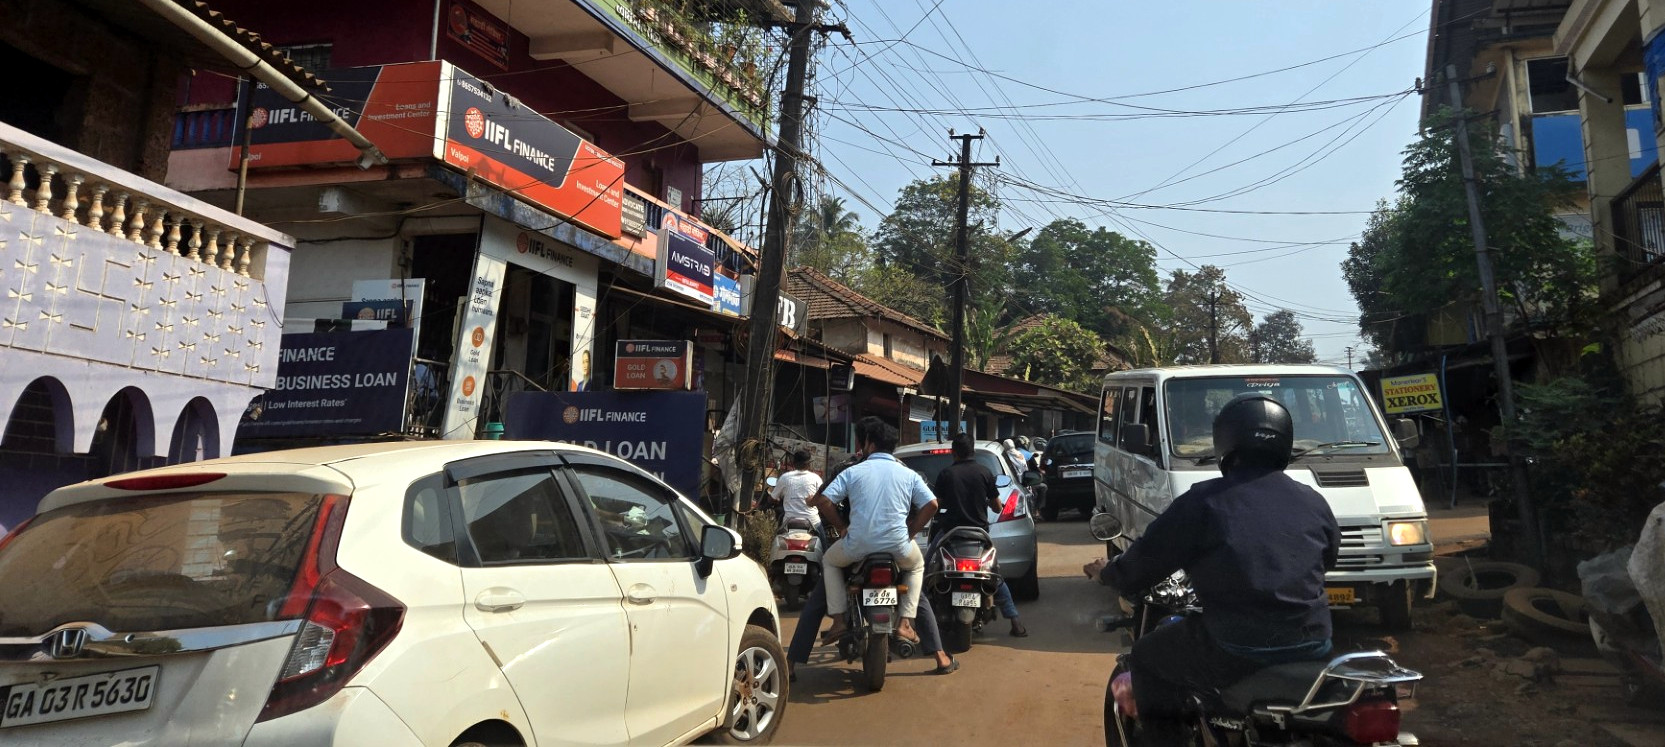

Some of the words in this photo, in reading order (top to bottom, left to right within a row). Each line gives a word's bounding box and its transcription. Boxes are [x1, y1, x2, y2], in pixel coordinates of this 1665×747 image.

[268, 108, 297, 124] IIFL
[407, 110, 430, 118] Center
[484, 119, 512, 151] IIFL
[513, 138, 555, 172] FINANCE
[608, 186, 620, 198] and
[528, 239, 545, 258] IIFL
[545, 250, 573, 268] FINANCE
[376, 308, 398, 320] IIFL
[635, 344, 651, 352] IIFL
[627, 363, 646, 371] GOLD
[275, 374, 351, 391] BUSINESS
[354, 372, 398, 388] LOAN
[1384, 384, 1436, 396] STATIONERY
[268, 400, 286, 410] Low
[287, 398, 320, 409] Interest
[1386, 393, 1439, 408] XEROX
[579, 408, 604, 422] IIFL
[605, 411, 647, 422] FINANCE
[6, 690, 35, 719] GA
[39, 685, 72, 715] 03
[72, 684, 89, 711] R
[91, 675, 152, 709] 5630
